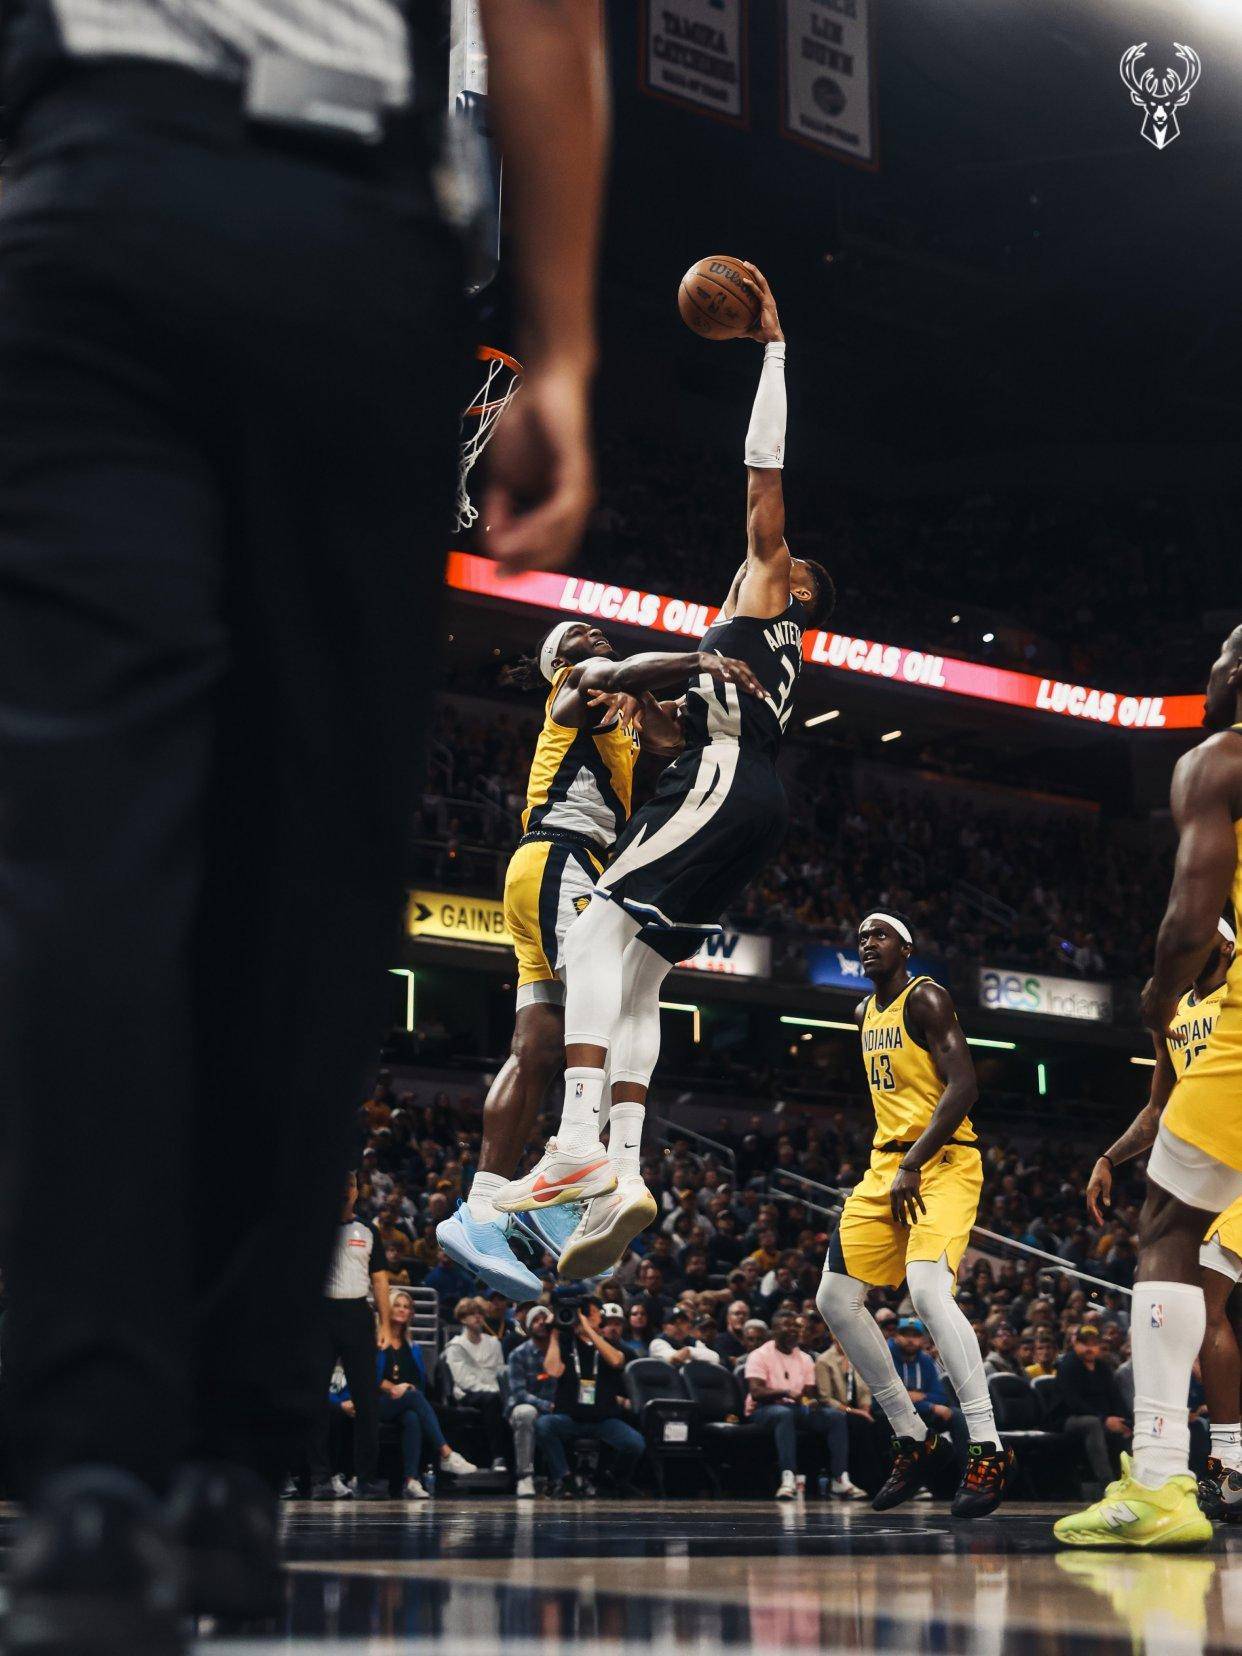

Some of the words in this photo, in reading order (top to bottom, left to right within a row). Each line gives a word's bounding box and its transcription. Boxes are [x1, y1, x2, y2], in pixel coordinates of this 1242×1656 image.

[558, 577, 660, 626] LUCAS
[661, 599, 709, 638] OIL
[811, 631, 902, 678] LUCAS
[902, 651, 946, 688] OIL
[1036, 689, 1118, 723] LUCAS
[1118, 697, 1167, 728] OIL
[441, 904, 506, 934] GAINB
[984, 972, 1039, 1010] aes
[863, 1027, 903, 1052] NDIANA
[871, 1055, 895, 1091] 43
